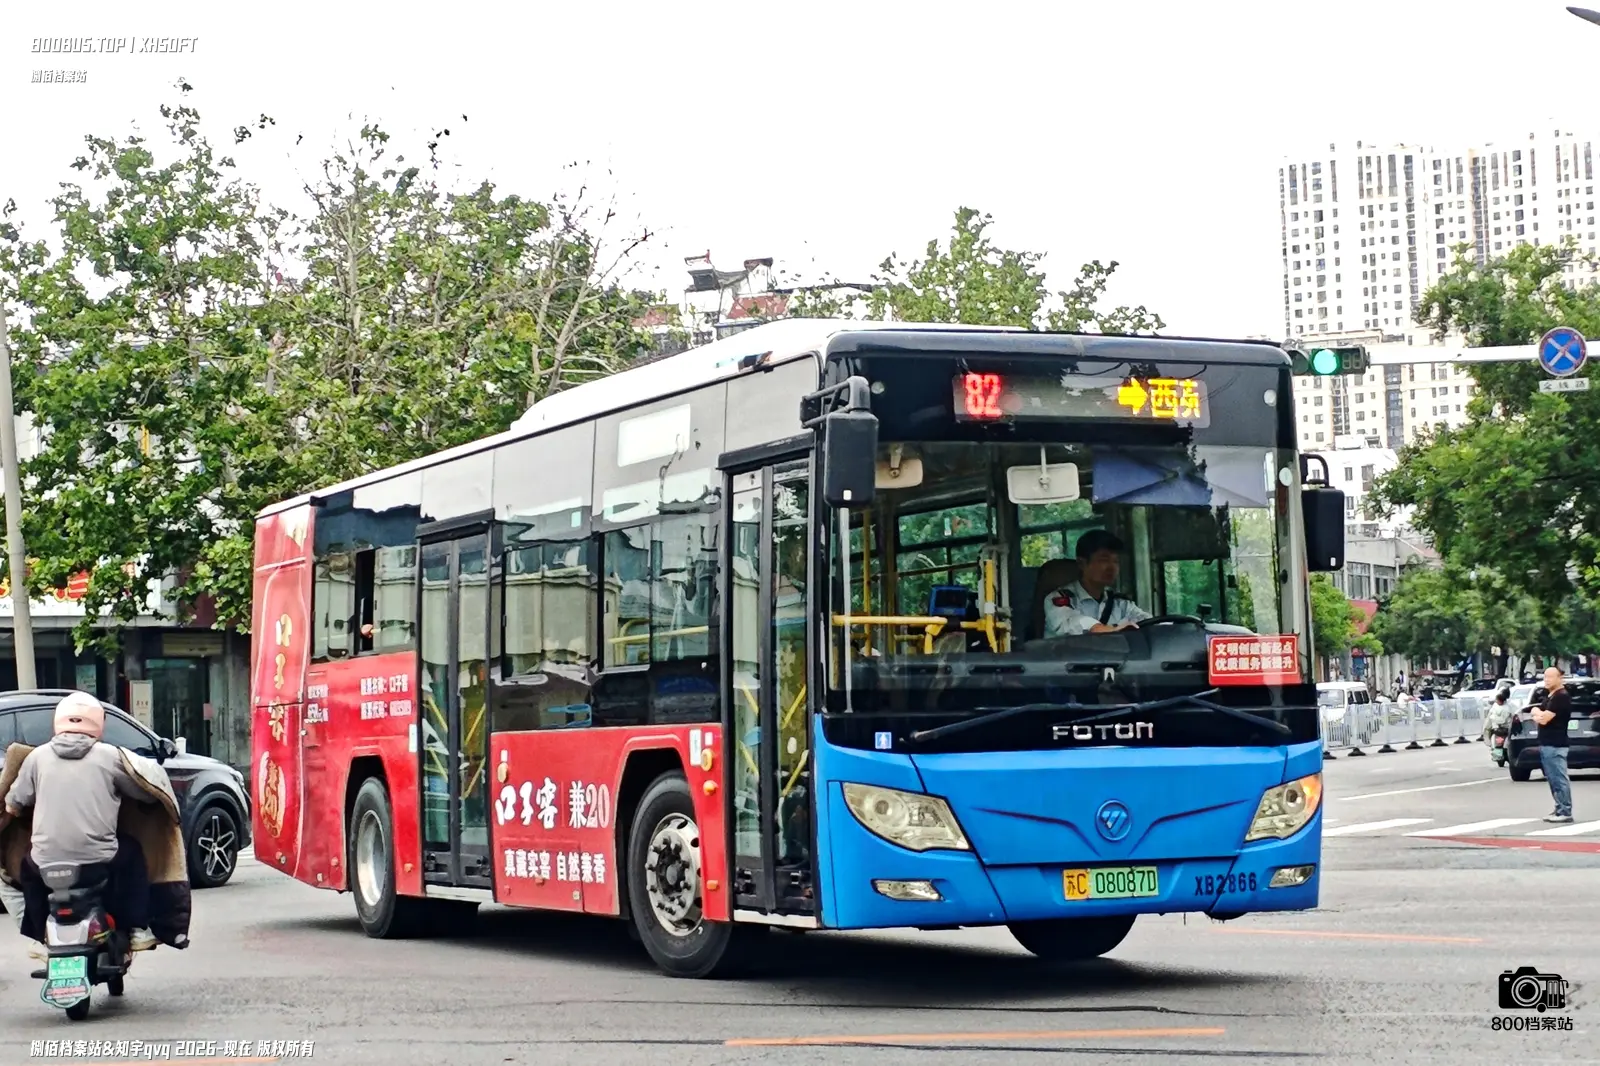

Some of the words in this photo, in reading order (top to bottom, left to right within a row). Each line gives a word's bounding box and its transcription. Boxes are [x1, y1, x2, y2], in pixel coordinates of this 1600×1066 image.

[965, 373, 1002, 417] 82
[1052, 721, 1154, 741] FOTON
[1194, 871, 1257, 897] XB2866
